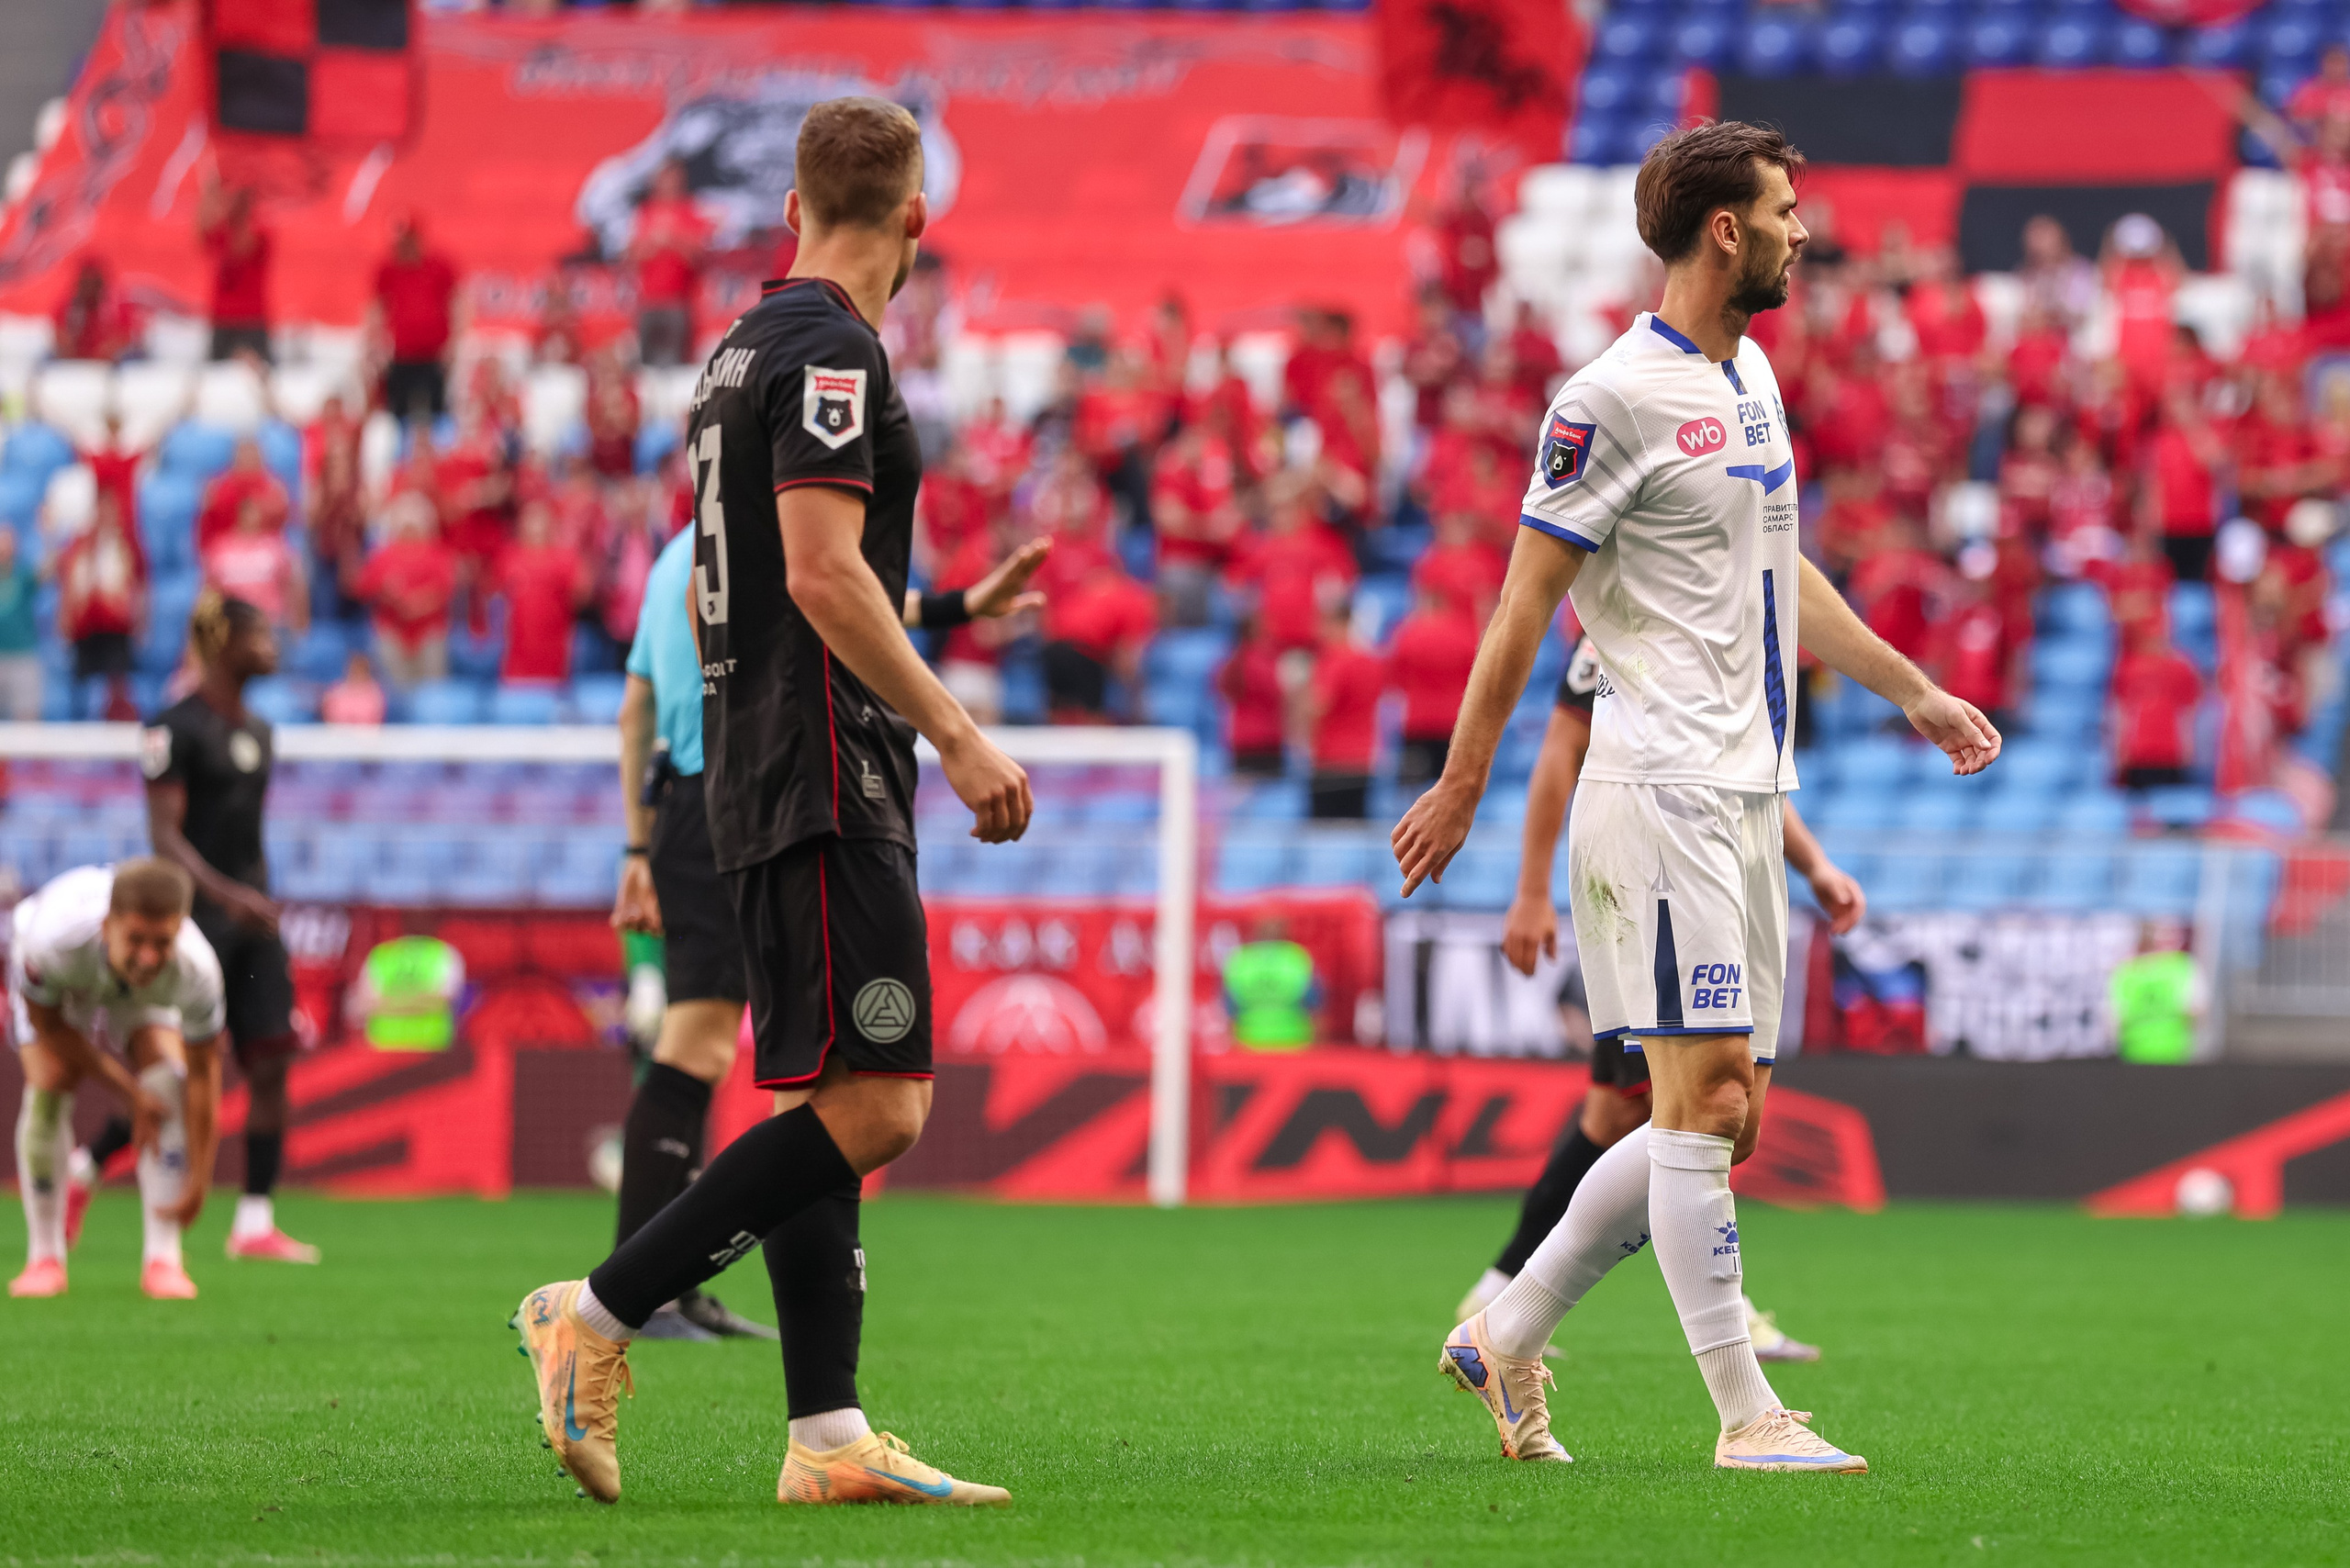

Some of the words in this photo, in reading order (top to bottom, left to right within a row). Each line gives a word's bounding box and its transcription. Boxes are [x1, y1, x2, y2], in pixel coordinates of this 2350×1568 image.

[1737, 400, 1766, 424] FON
[1681, 420, 1722, 451] wb
[1745, 422, 1771, 447] BET
[1691, 963, 1740, 985] FON
[1692, 988, 1741, 1009] BET
